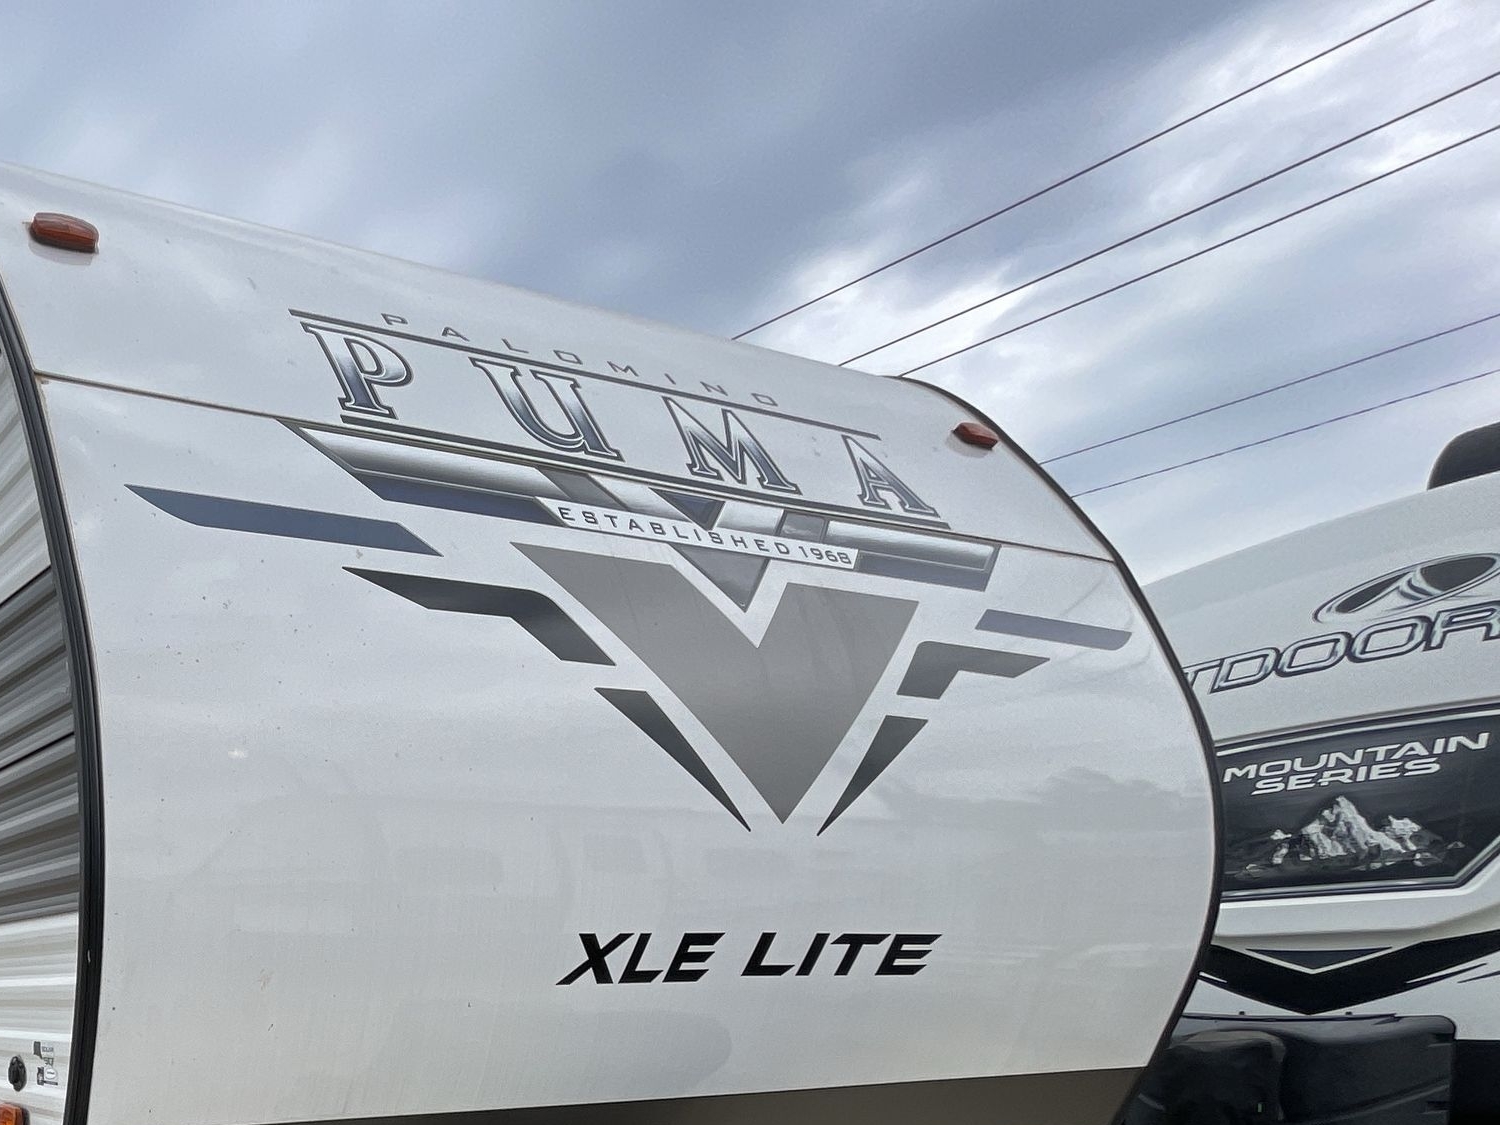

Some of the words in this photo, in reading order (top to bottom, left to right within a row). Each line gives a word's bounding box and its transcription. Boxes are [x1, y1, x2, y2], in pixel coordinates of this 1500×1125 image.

[381, 312, 779, 406] PALOMINO
[300, 320, 949, 518] PUMA
[557, 505, 791, 555] ESTABLISHED
[1222, 731, 1490, 783] MOUNTAIN
[1250, 757, 1441, 796] SERIES
[555, 931, 726, 986] XLE
[740, 931, 943, 977] LITE
